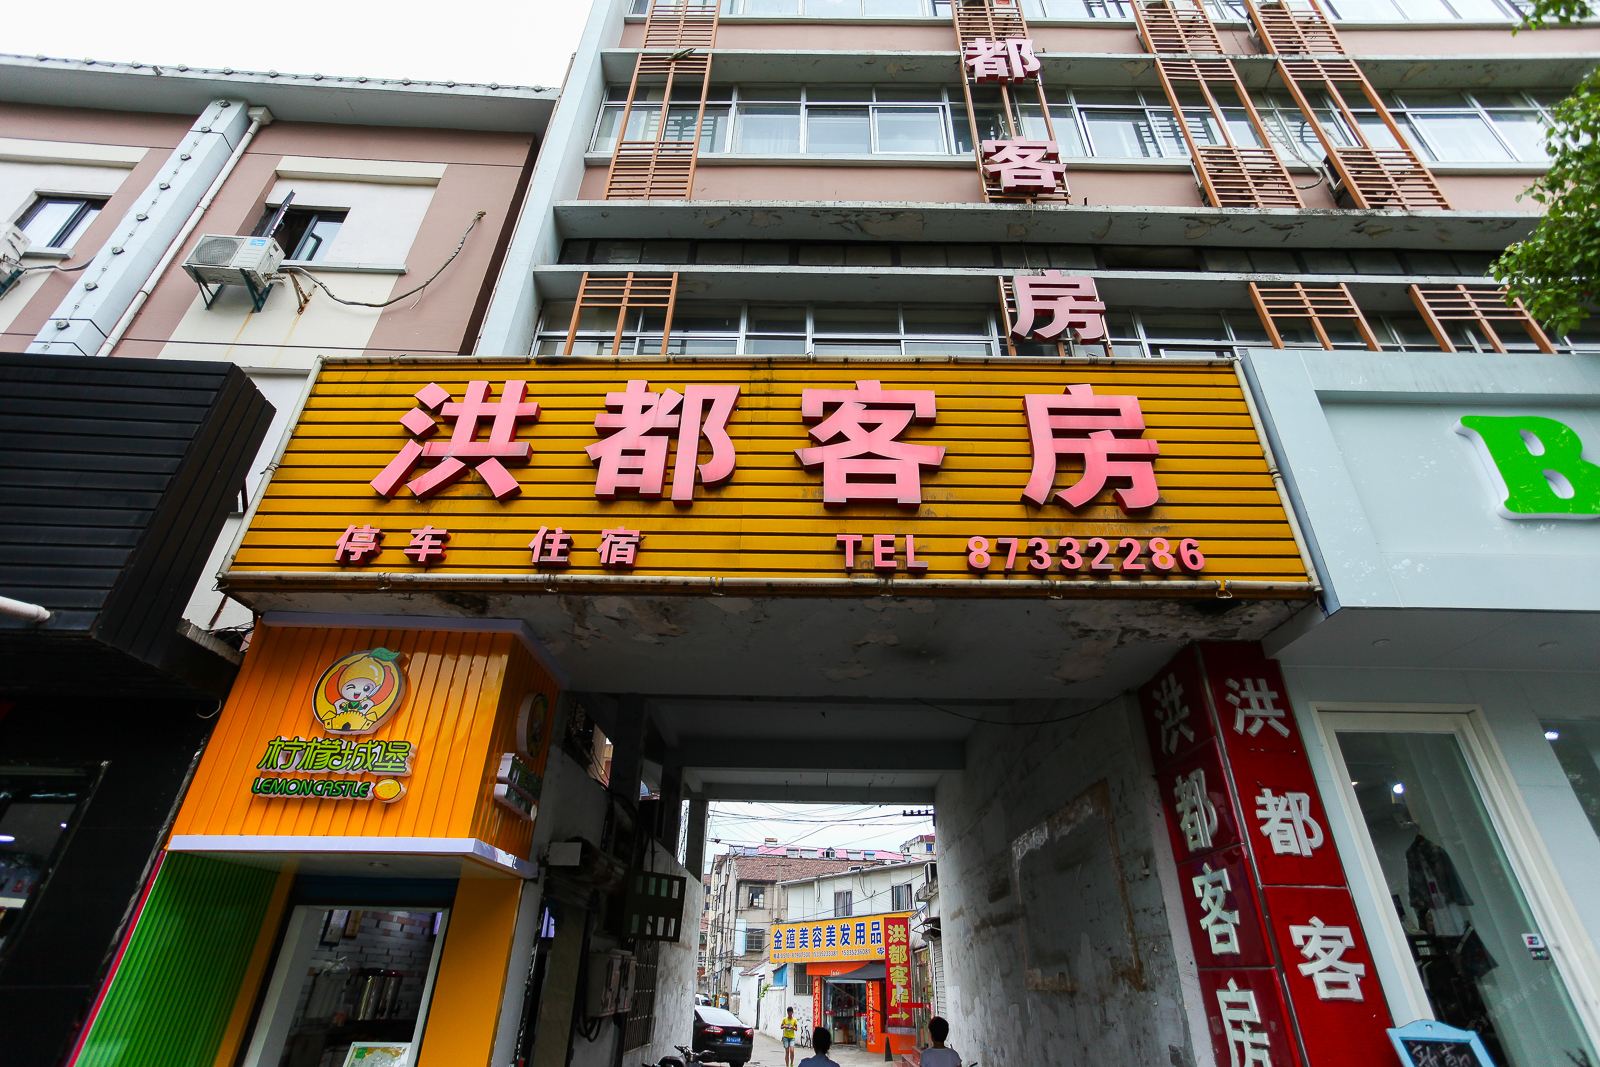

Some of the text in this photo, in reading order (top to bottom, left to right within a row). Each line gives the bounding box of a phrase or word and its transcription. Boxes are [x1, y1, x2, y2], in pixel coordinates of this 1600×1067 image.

[370, 379, 1160, 513] 洪都客房
[836, 533, 1206, 574] TEL 87332286
[256, 736, 412, 773] 柠檬城堡
[1225, 677, 1366, 1003] 洪都客
